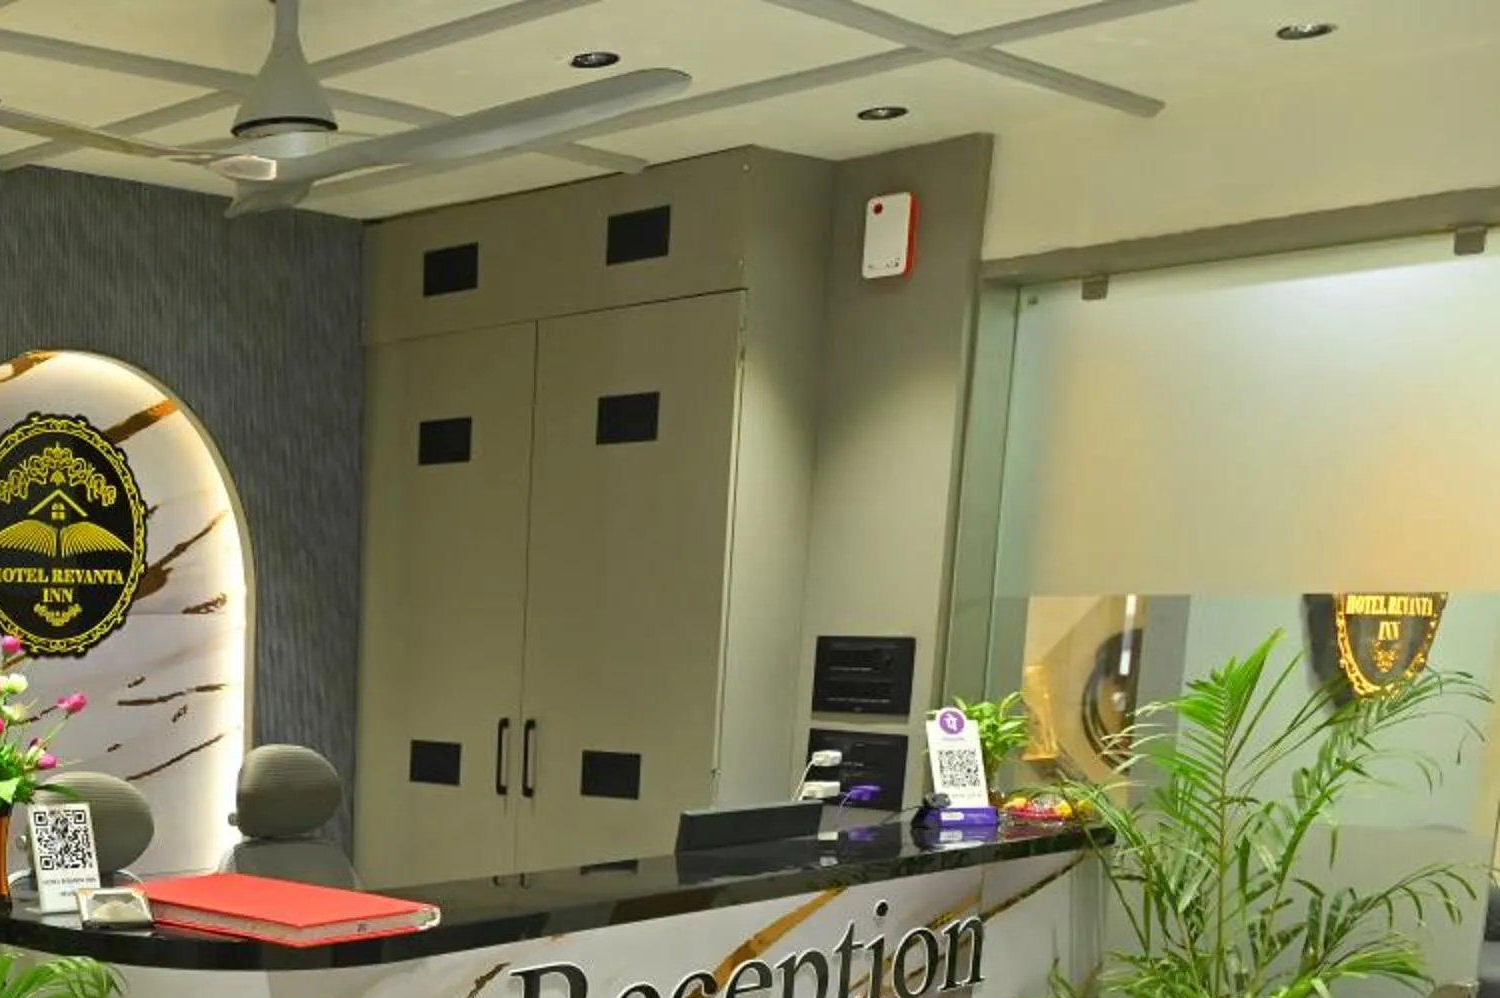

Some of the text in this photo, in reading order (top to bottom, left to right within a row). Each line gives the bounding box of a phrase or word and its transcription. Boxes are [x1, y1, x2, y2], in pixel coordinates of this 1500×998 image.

[51, 568, 124, 585] REVANTA
[43, 588, 73, 603] INN
[1346, 595, 1387, 615] HOTEL
